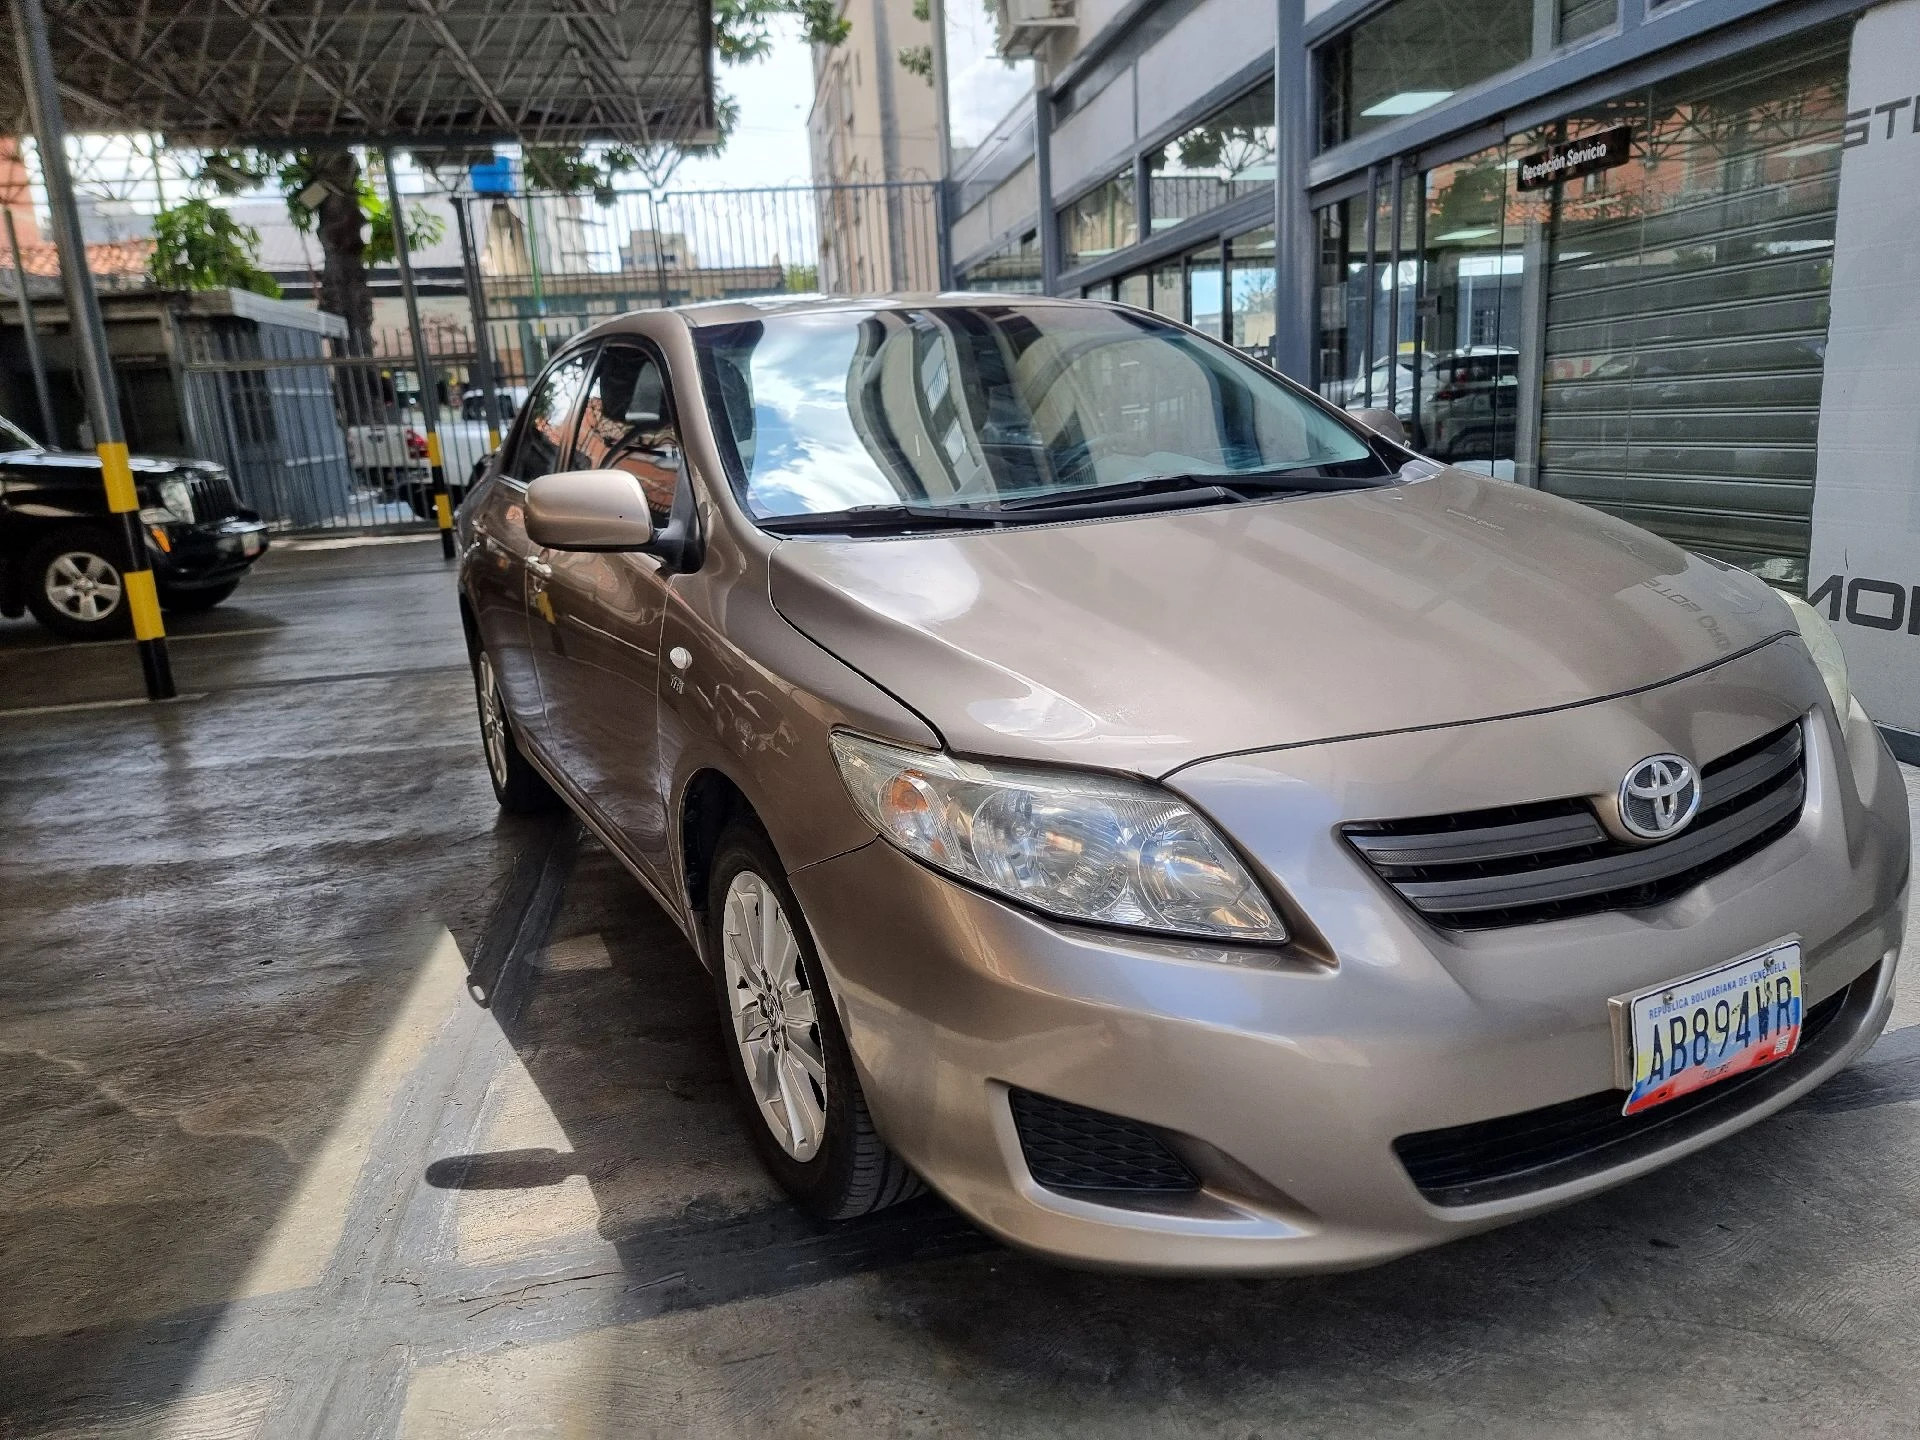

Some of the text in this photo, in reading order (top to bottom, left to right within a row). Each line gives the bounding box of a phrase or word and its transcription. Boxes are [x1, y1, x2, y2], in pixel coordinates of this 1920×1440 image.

[1523, 142, 1607, 180] Recepción Servicio
[1691, 982, 1737, 1004] BOLIVARIANA
[1738, 976, 1748, 987] DE
[1749, 961, 1788, 983] VENEZUELA
[1647, 976, 1793, 1086] AB894WR
